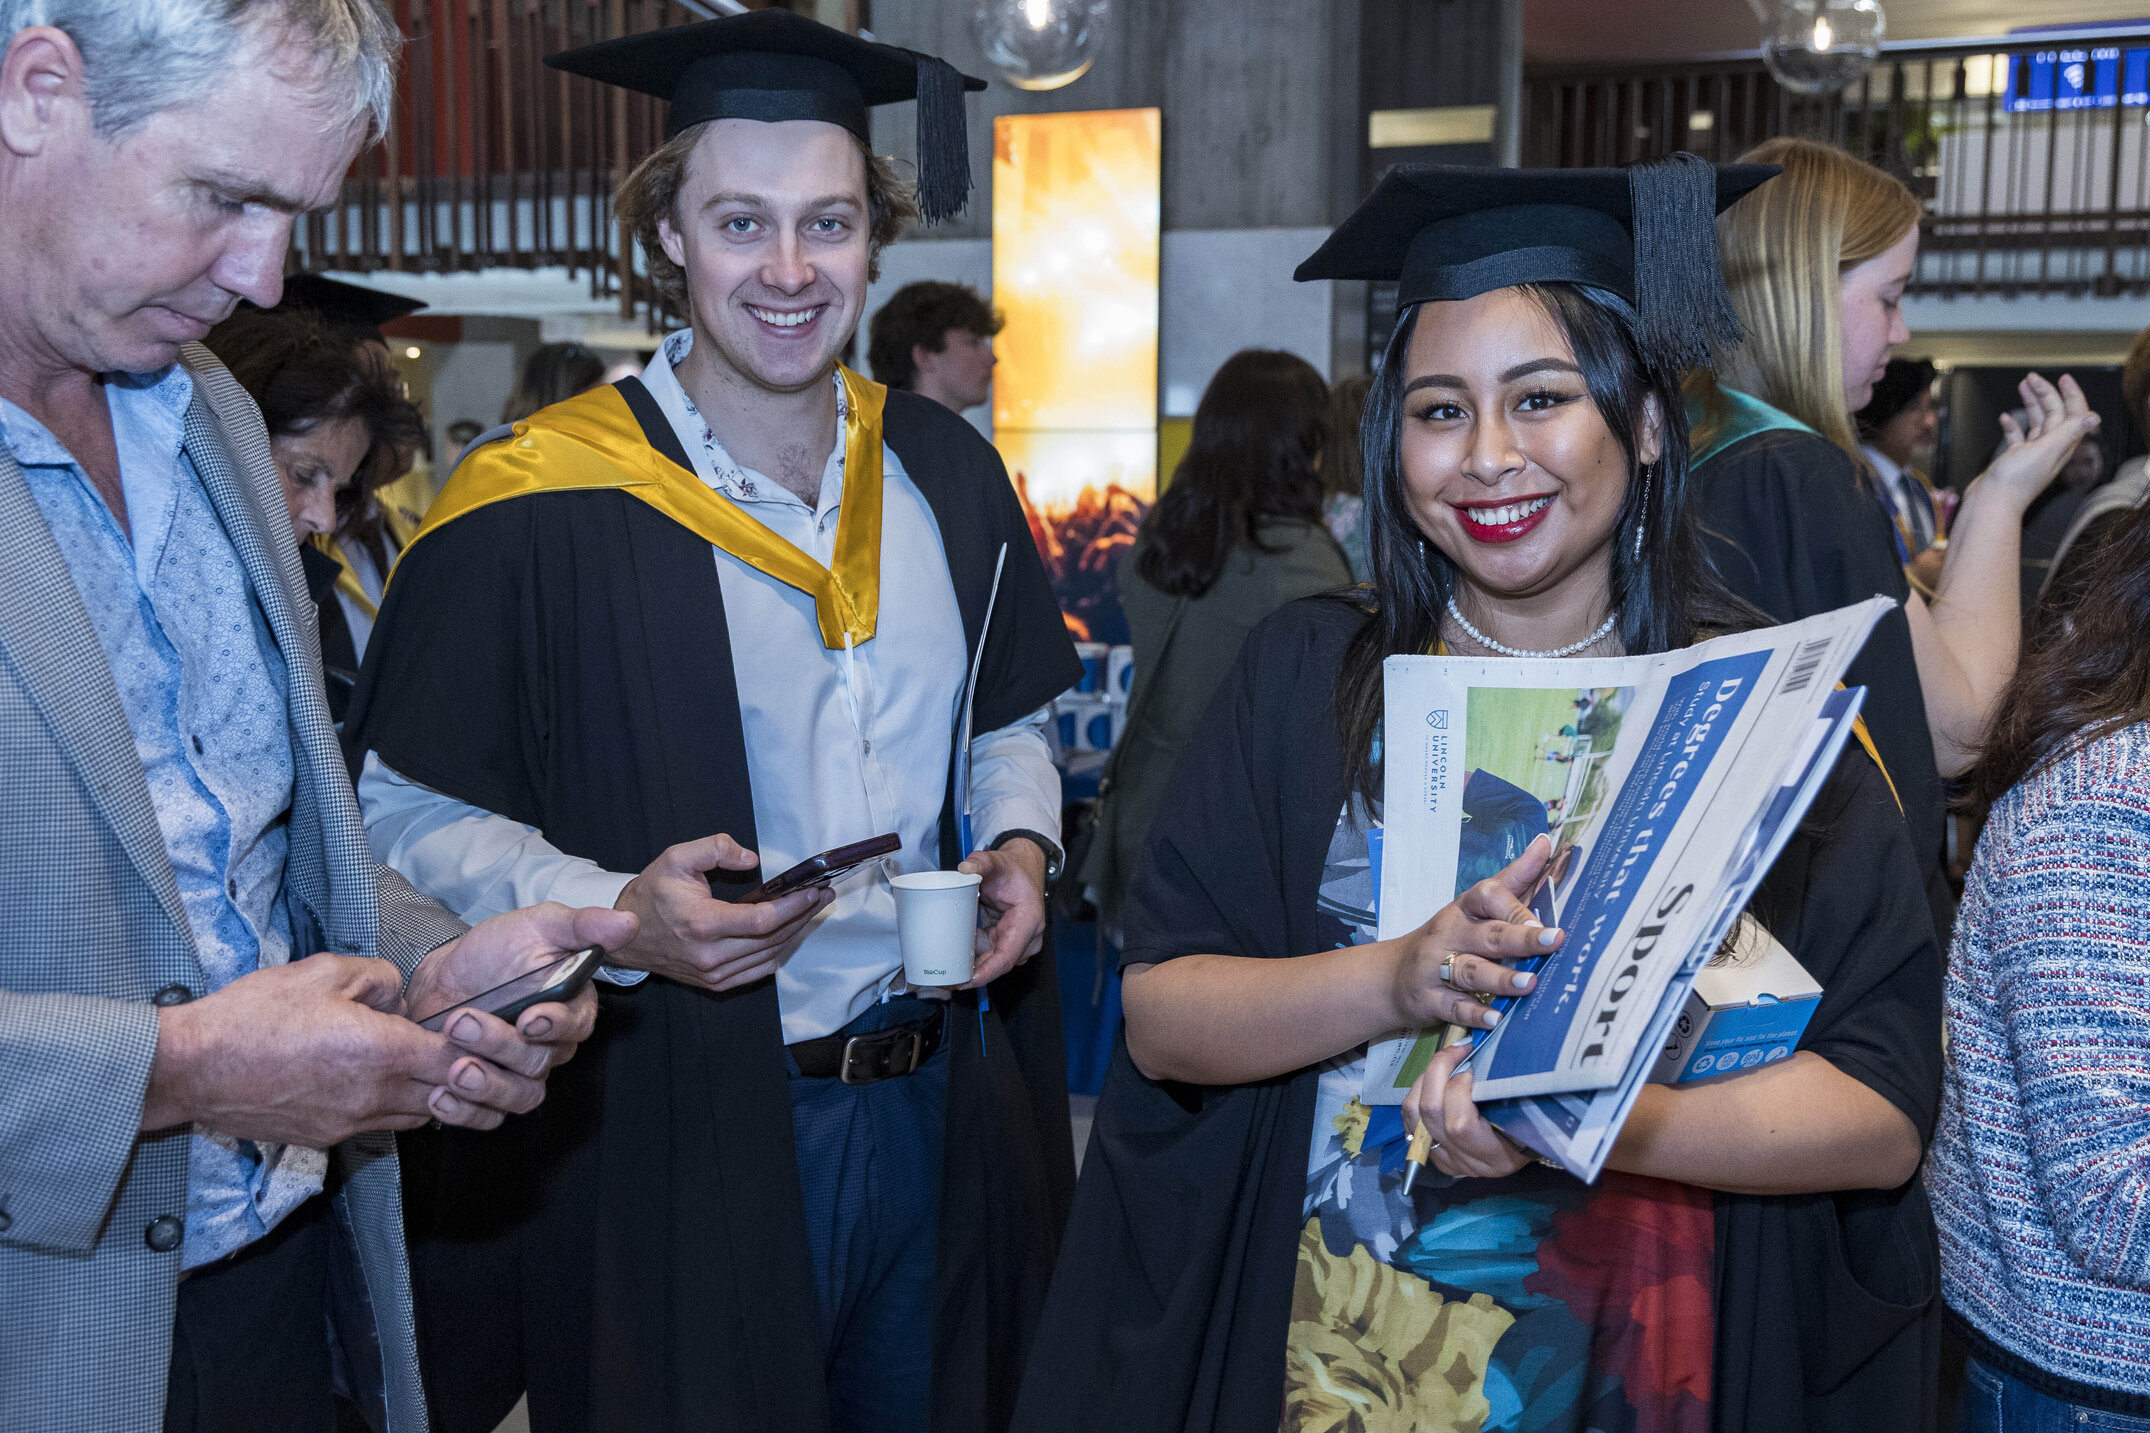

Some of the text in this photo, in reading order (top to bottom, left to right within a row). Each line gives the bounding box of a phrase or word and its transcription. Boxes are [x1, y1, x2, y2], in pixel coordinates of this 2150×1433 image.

[1668, 730, 1681, 747] at
[1678, 680, 1710, 726] Study
[1430, 735, 1440, 813] UNIVERSITY
[1439, 735, 1448, 789] LINCOLN
[1635, 751, 1672, 811] Lincoln
[1647, 677, 1742, 819] Degrees
[1593, 815, 1638, 898] University
[1605, 828, 1652, 899] that
[1554, 914, 1606, 1013] work.
[1579, 883, 1694, 1067] Sport
